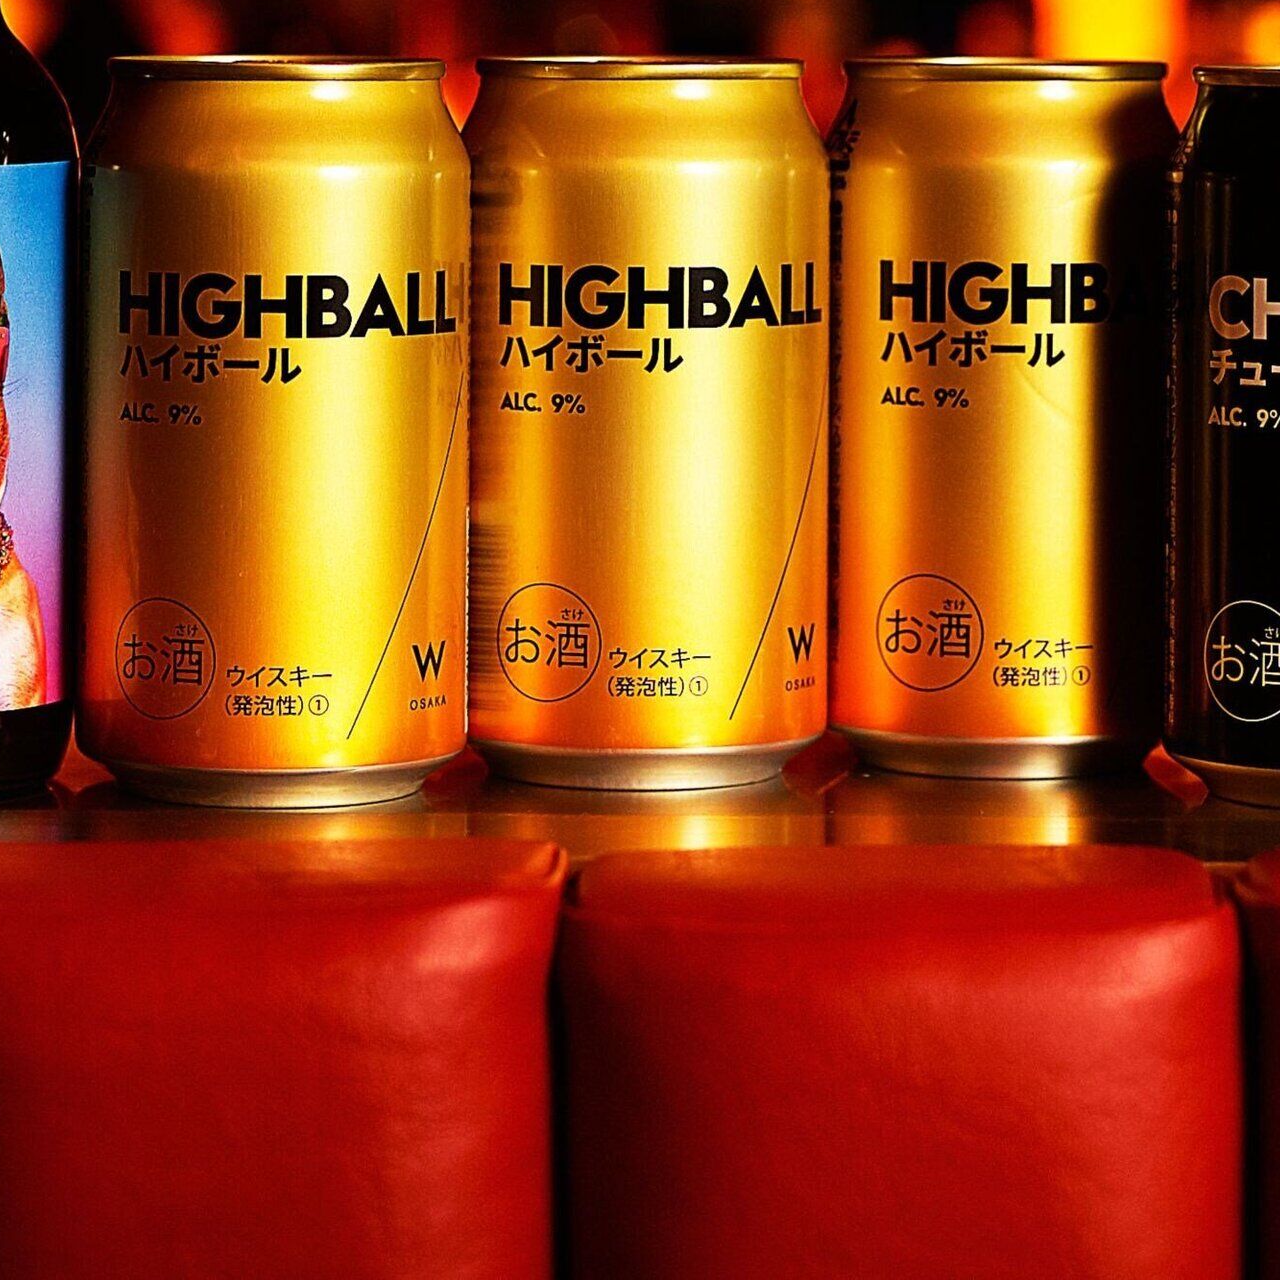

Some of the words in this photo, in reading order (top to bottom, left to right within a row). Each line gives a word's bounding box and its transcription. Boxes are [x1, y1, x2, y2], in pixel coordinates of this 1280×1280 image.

[498, 262, 823, 330] HIGHBALL
[879, 260, 1114, 325] HIGHB
[119, 270, 457, 339] HIGHBALL
[500, 334, 684, 373] ハイボール
[880, 329, 1066, 367] ハイボール
[119, 344, 302, 384] ハイボール
[500, 392, 542, 412] ALC.
[551, 394, 586, 414] 9%
[880, 387, 924, 407] ALC.
[934, 388, 970, 408] 9%
[120, 403, 160, 422] ALC.
[169, 404, 202, 425] 9%
[1208, 407, 1247, 427] ALC.
[561, 608, 585, 620] さけ
[942, 598, 966, 610] さけ
[175, 623, 200, 637] さけ
[885, 609, 973, 659] お酒
[505, 618, 590, 669] お酒
[787, 623, 815, 664] W
[994, 638, 1094, 659] ウイスキー
[123, 633, 205, 686] お酒
[412, 640, 446, 683] W
[608, 648, 711, 669] ウイスキー
[226, 665, 333, 687] ウイスキー
[785, 677, 816, 692] OSAKA
[410, 695, 447, 712] OSAKA
